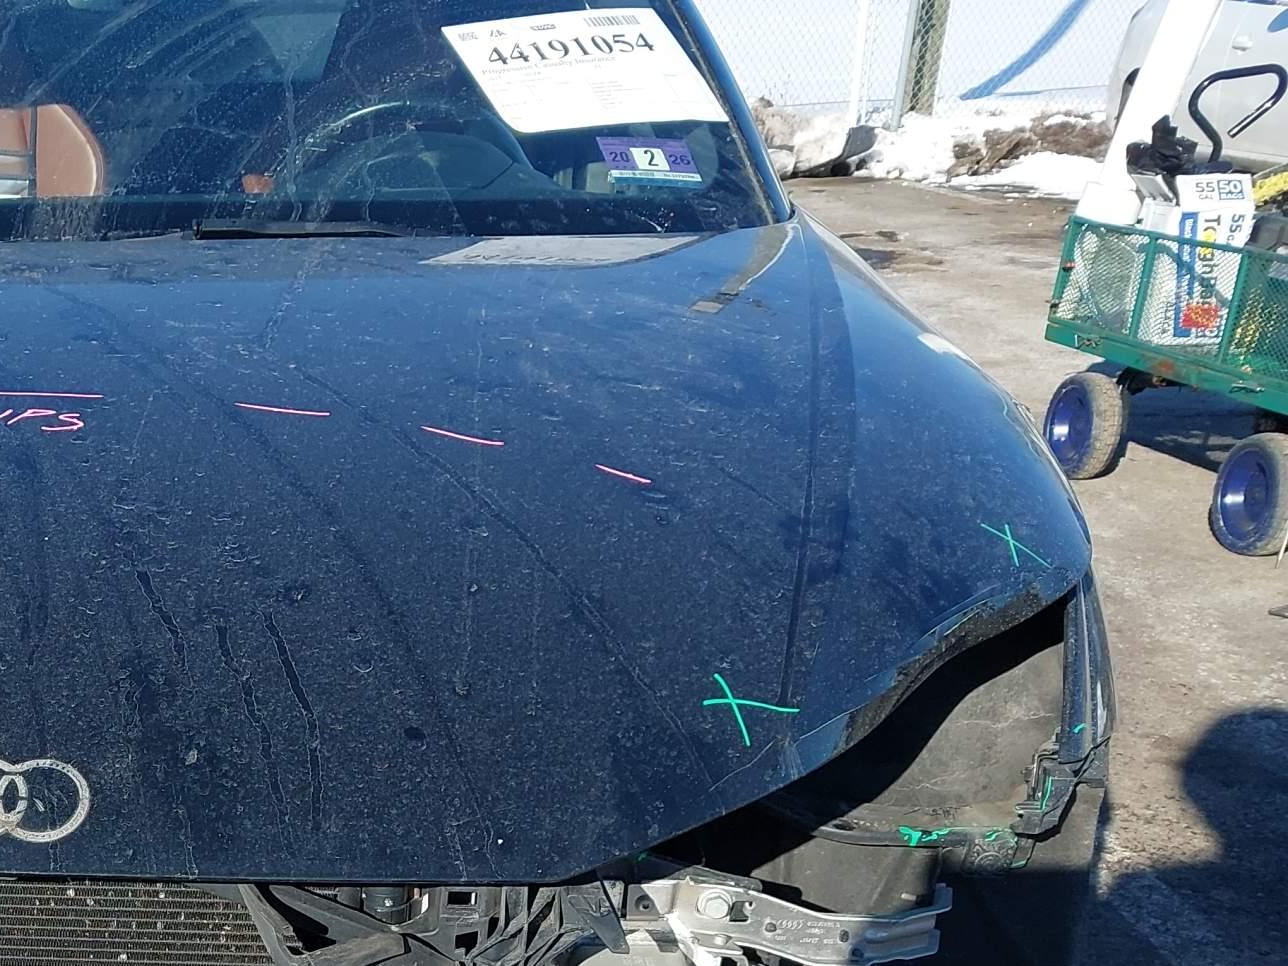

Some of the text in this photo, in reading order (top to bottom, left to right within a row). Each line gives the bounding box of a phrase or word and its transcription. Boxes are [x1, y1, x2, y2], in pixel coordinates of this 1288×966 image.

[488, 33, 655, 65] 44191054
[609, 149, 691, 167] 20 2 26
[1195, 181, 1215, 193] 55
[1218, 180, 1242, 193] 50
[1229, 213, 1246, 233] 55
